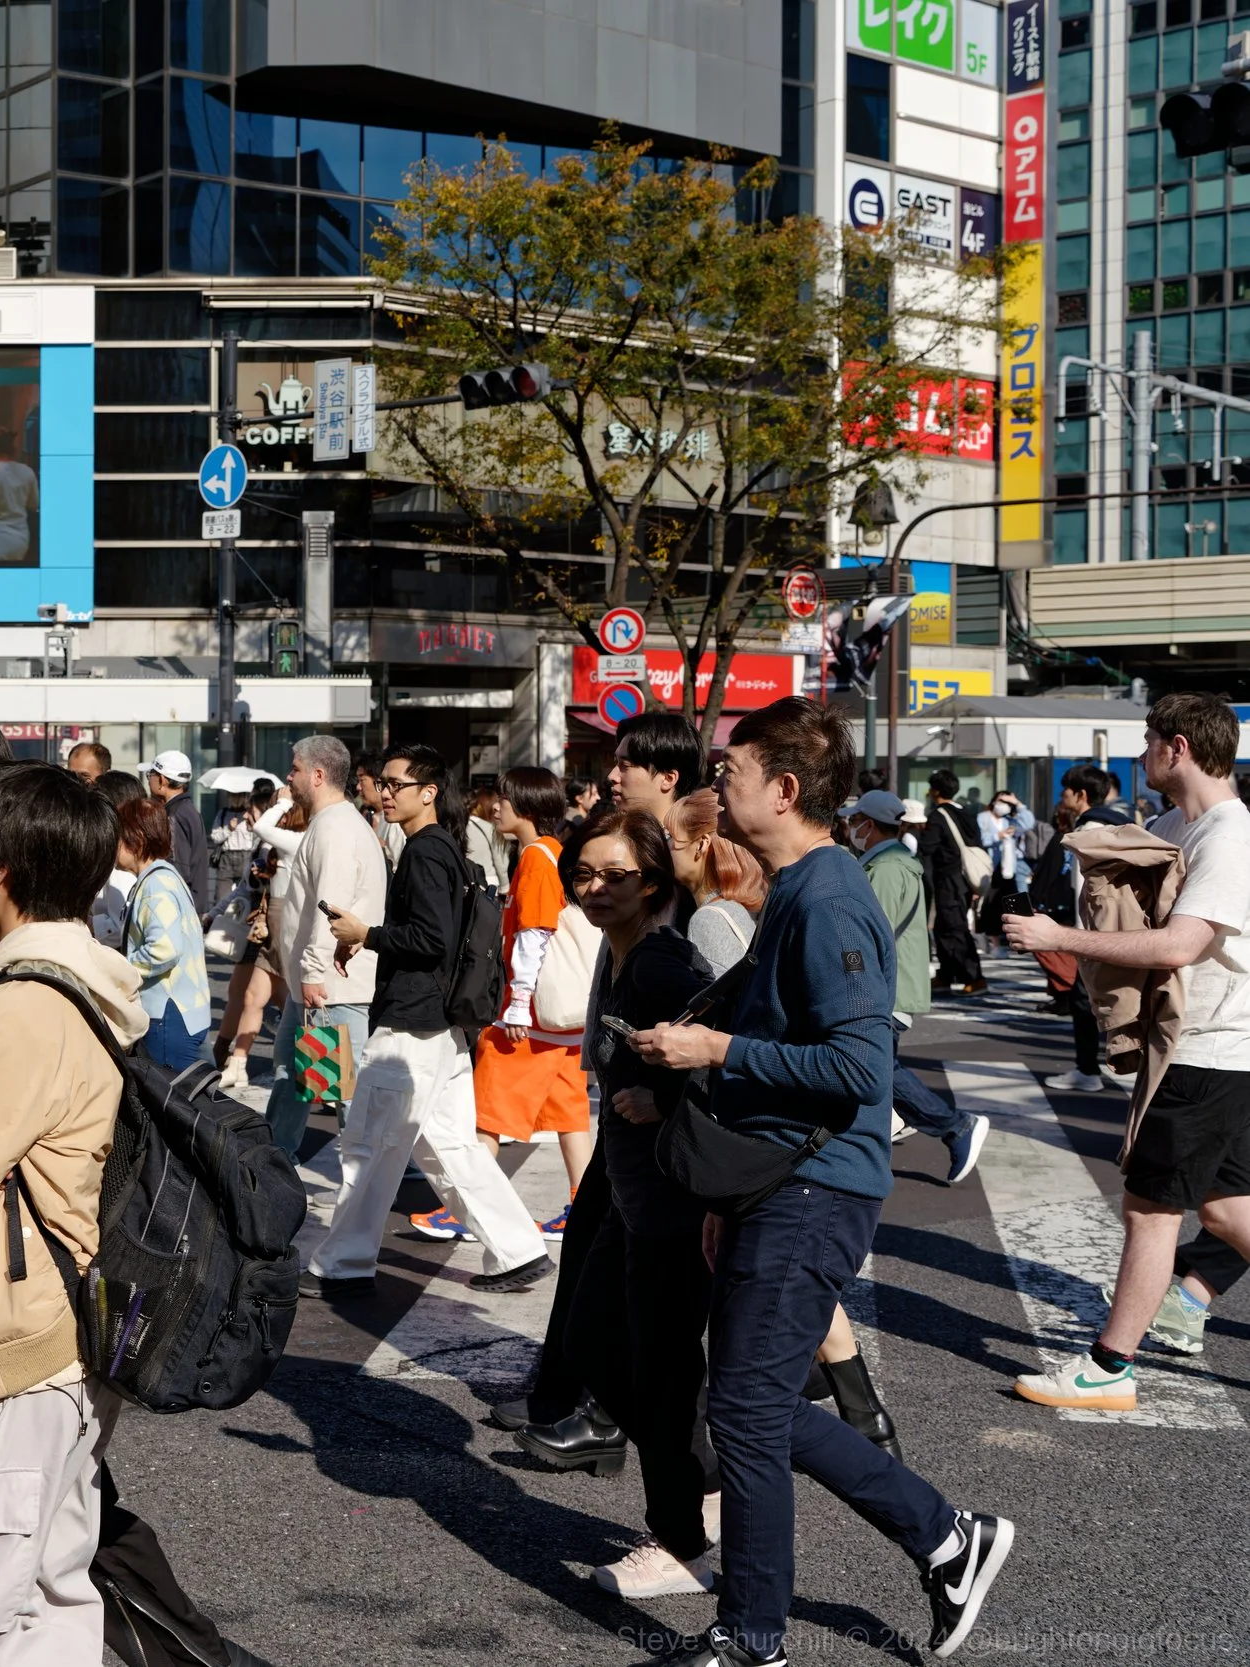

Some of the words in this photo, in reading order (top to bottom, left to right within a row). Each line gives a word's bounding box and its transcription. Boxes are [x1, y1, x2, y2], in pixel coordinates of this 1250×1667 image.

[865, 0, 948, 45] レイク
[967, 42, 987, 75] 5F
[1012, 16, 1026, 77] クリニック
[898, 188, 952, 217] EAST
[1013, 147, 1038, 223] アコム
[962, 219, 986, 253] 4F
[319, 382, 328, 420] Shibuya
[329, 367, 345, 451] 渋谷駅前
[245, 426, 315, 446] COFF
[418, 623, 495, 655] MAGNET
